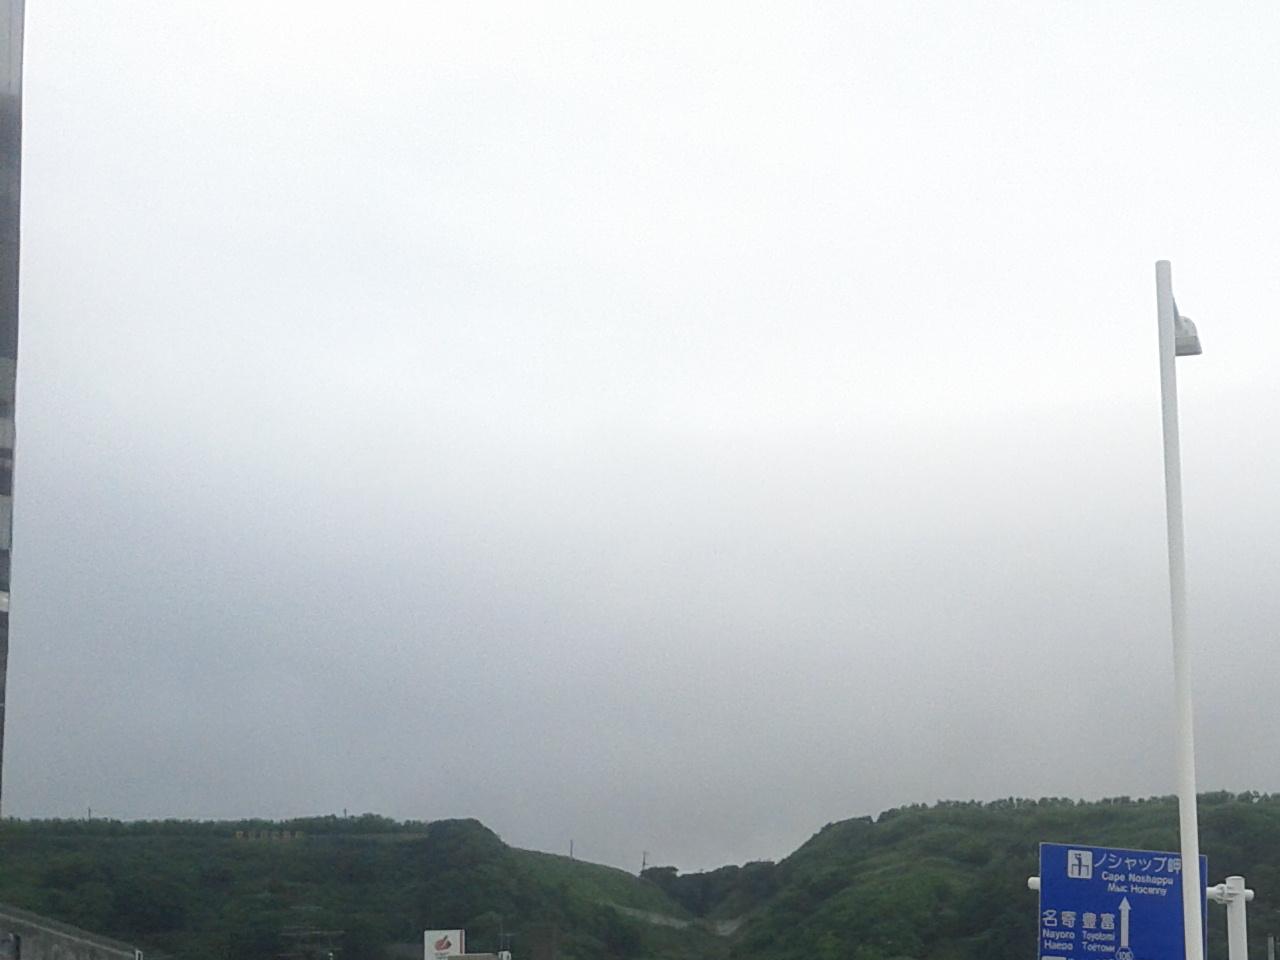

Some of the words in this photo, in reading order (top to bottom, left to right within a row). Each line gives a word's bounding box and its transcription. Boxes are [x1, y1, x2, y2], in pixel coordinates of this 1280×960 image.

[1094, 853, 1181, 874] ノシャップ岬
[1102, 871, 1126, 882] Cape
[1128, 873, 1174, 886] Noshappu
[1043, 909, 1077, 928] 名寄
[1043, 929, 1075, 939] Nayoro
